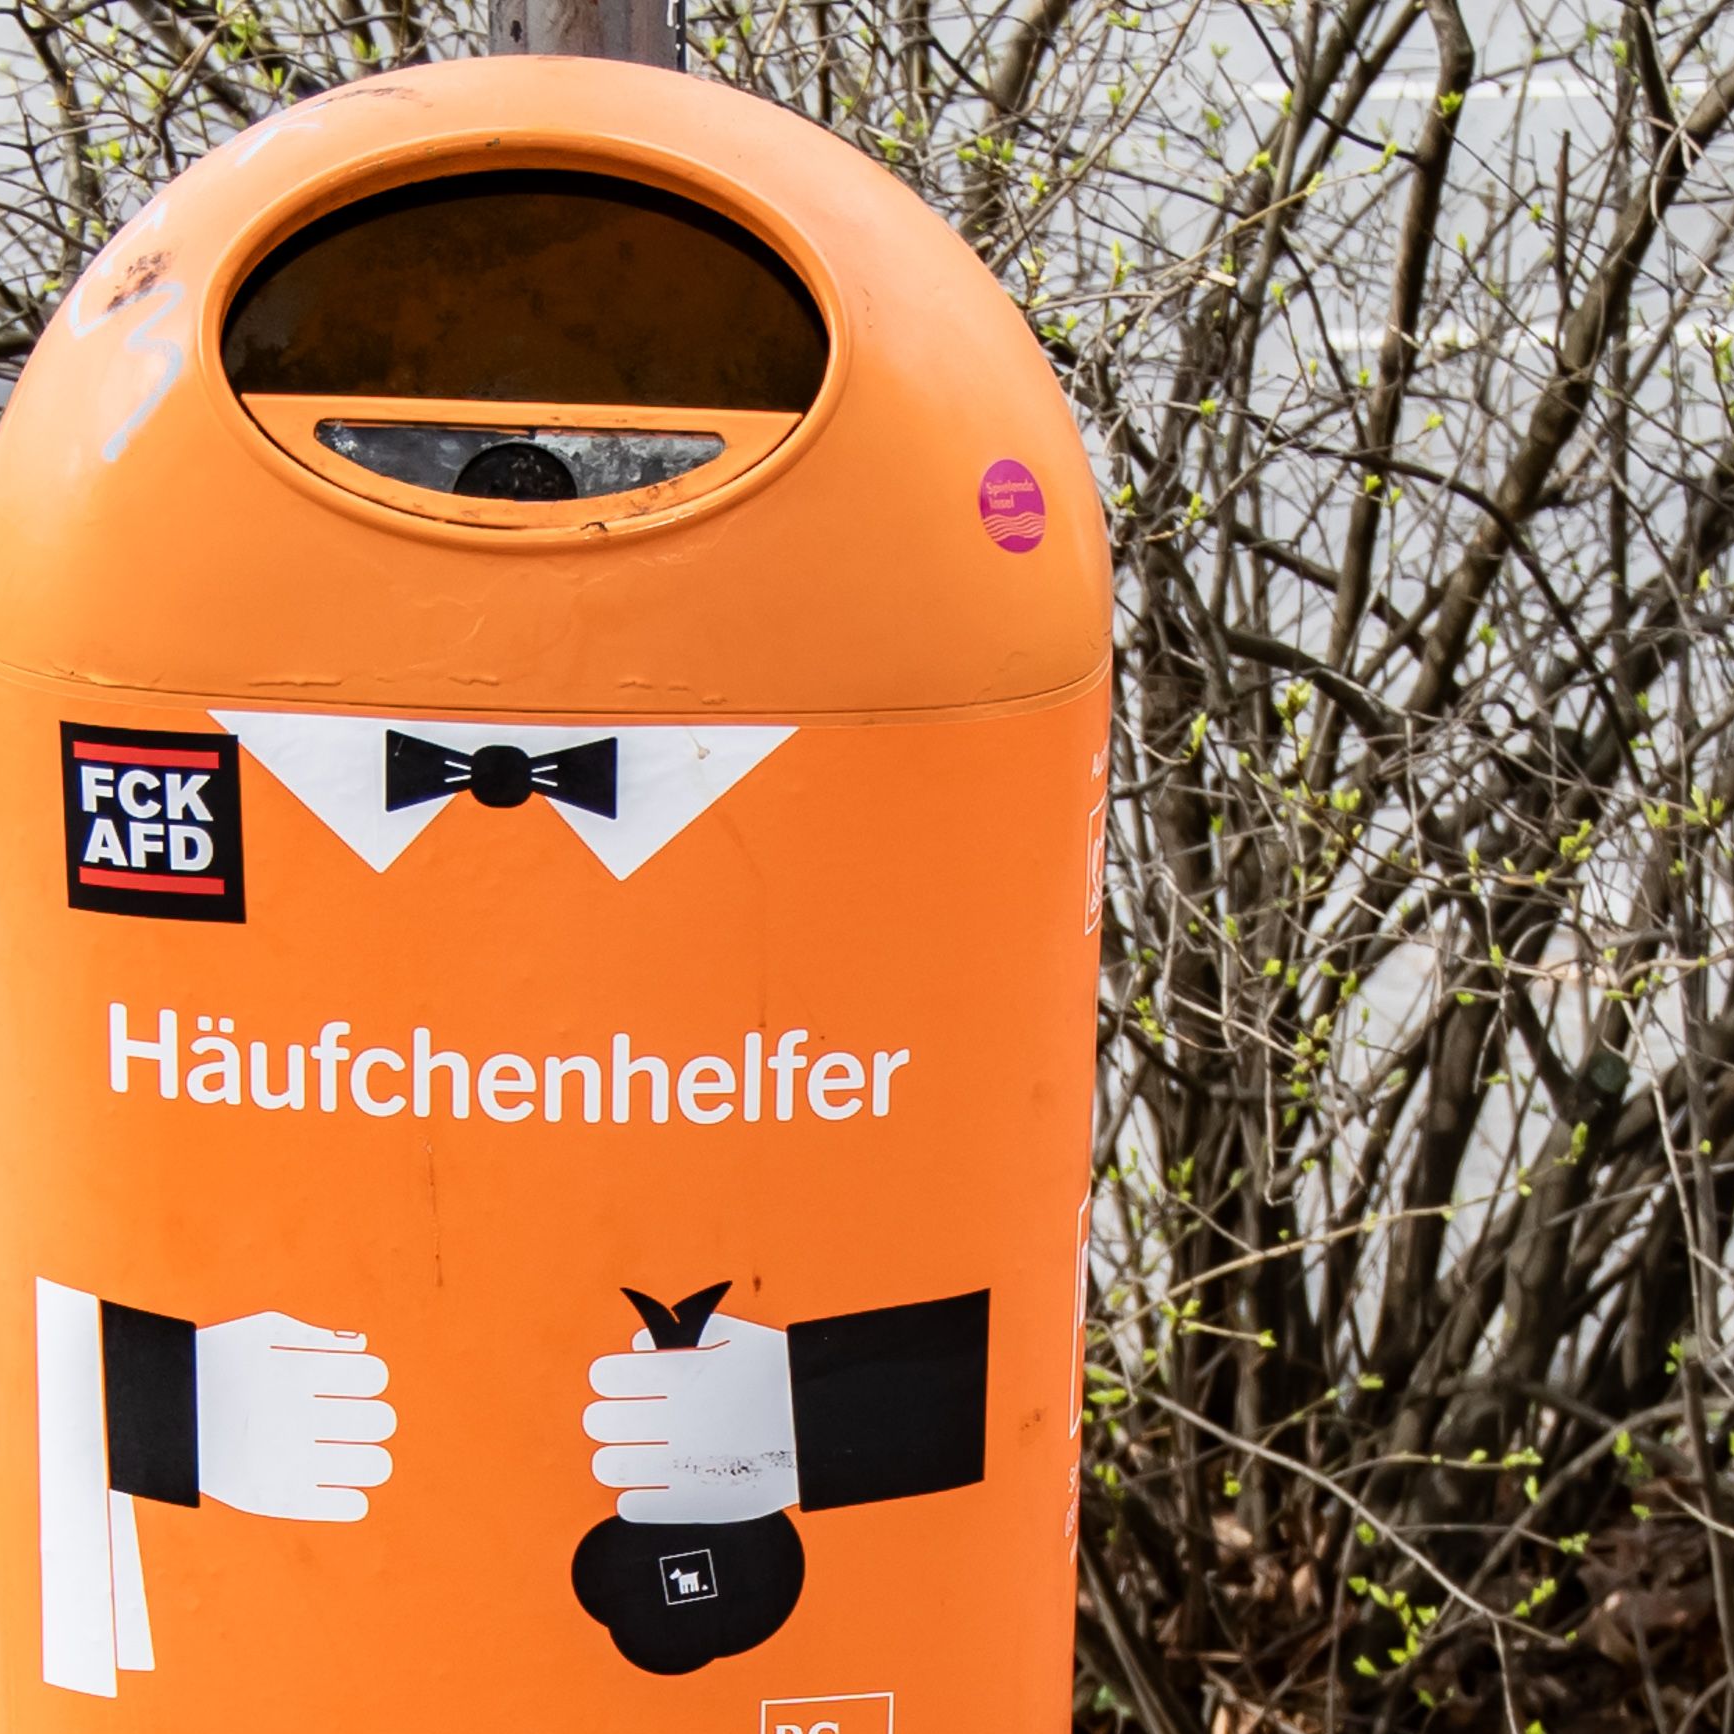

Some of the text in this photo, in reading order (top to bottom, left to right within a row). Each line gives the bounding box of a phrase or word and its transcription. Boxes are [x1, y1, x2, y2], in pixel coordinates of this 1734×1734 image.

[79, 765, 214, 823] FCK
[83, 819, 213, 872] AFD
[108, 1002, 910, 1125] Häufchenhelfer
